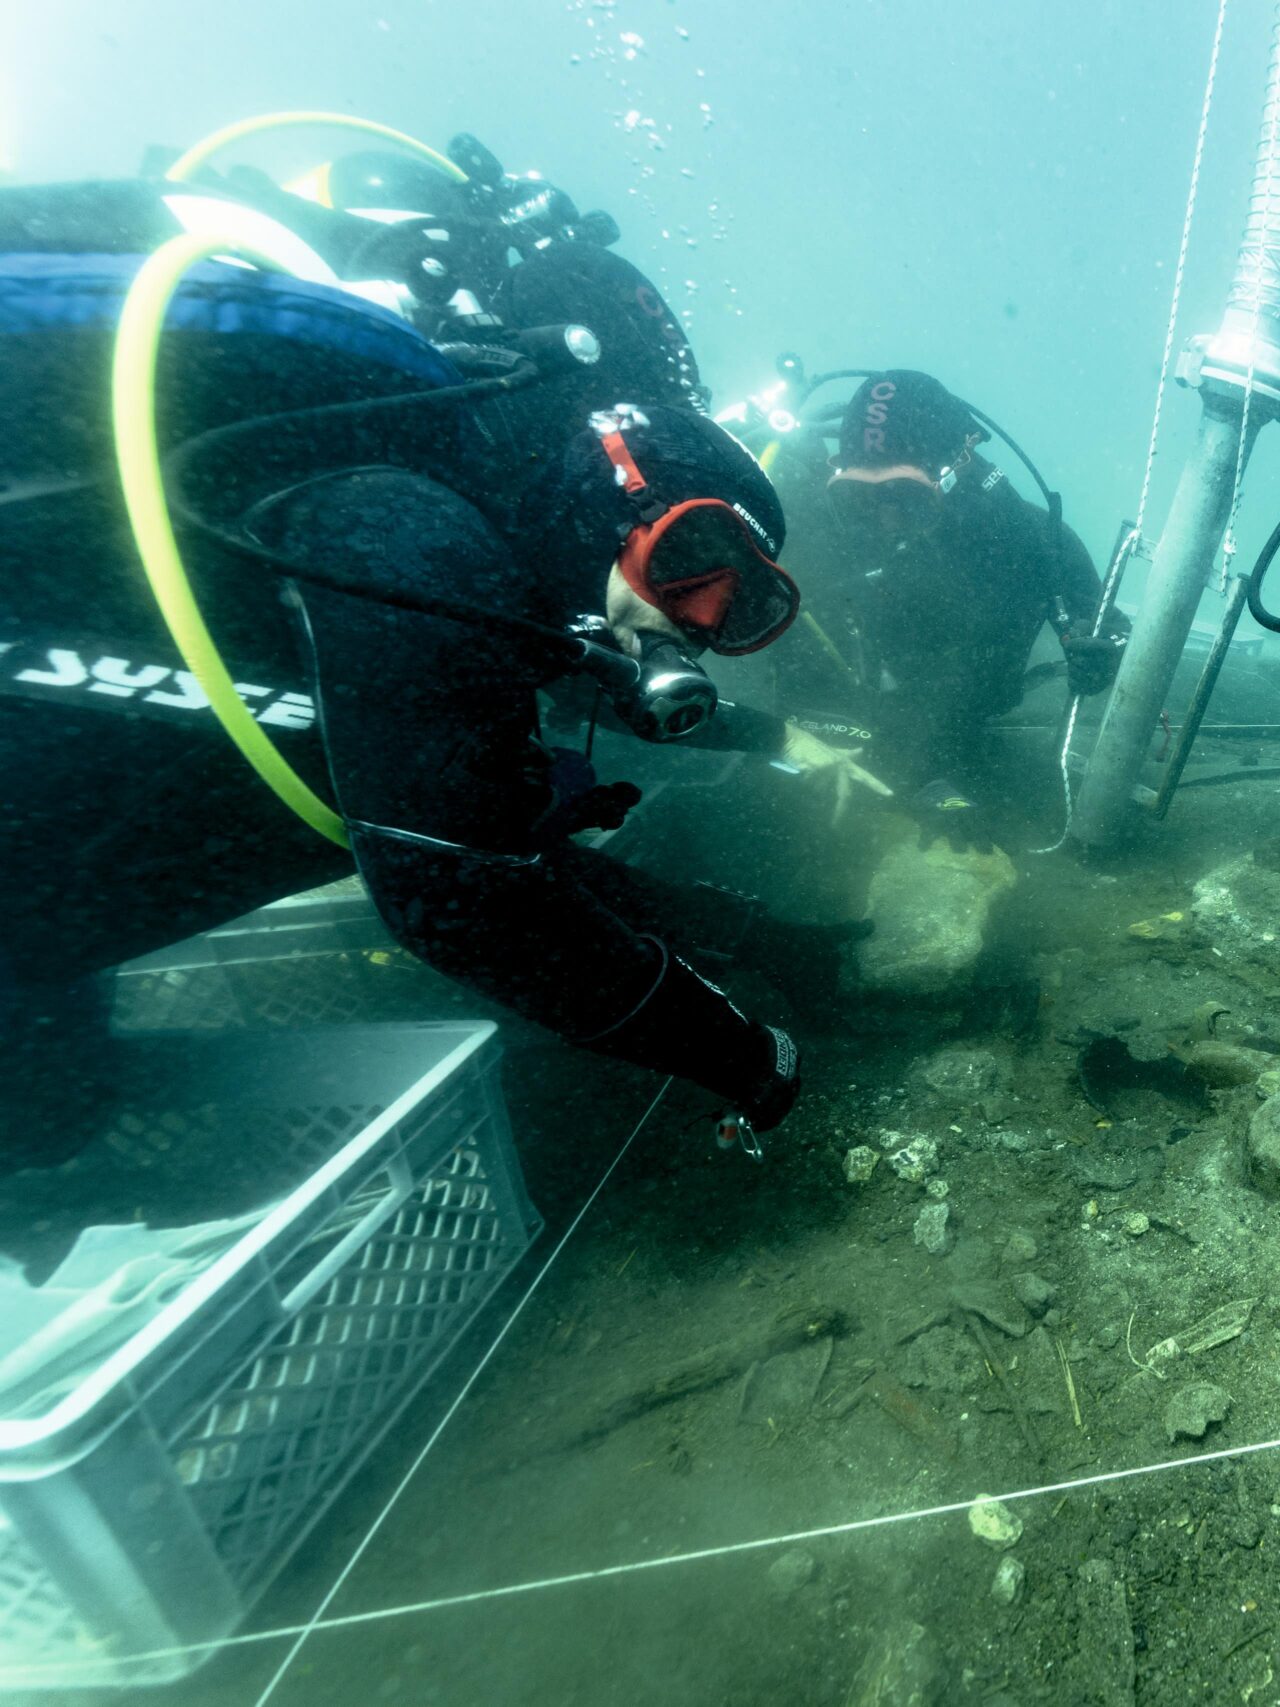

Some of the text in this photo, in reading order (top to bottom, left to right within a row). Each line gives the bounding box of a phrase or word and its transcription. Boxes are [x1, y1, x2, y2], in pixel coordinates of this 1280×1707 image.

[863, 381, 897, 452] CSR
[732, 502, 768, 540] BEUCHAT
[848, 726, 872, 739] 7.0
